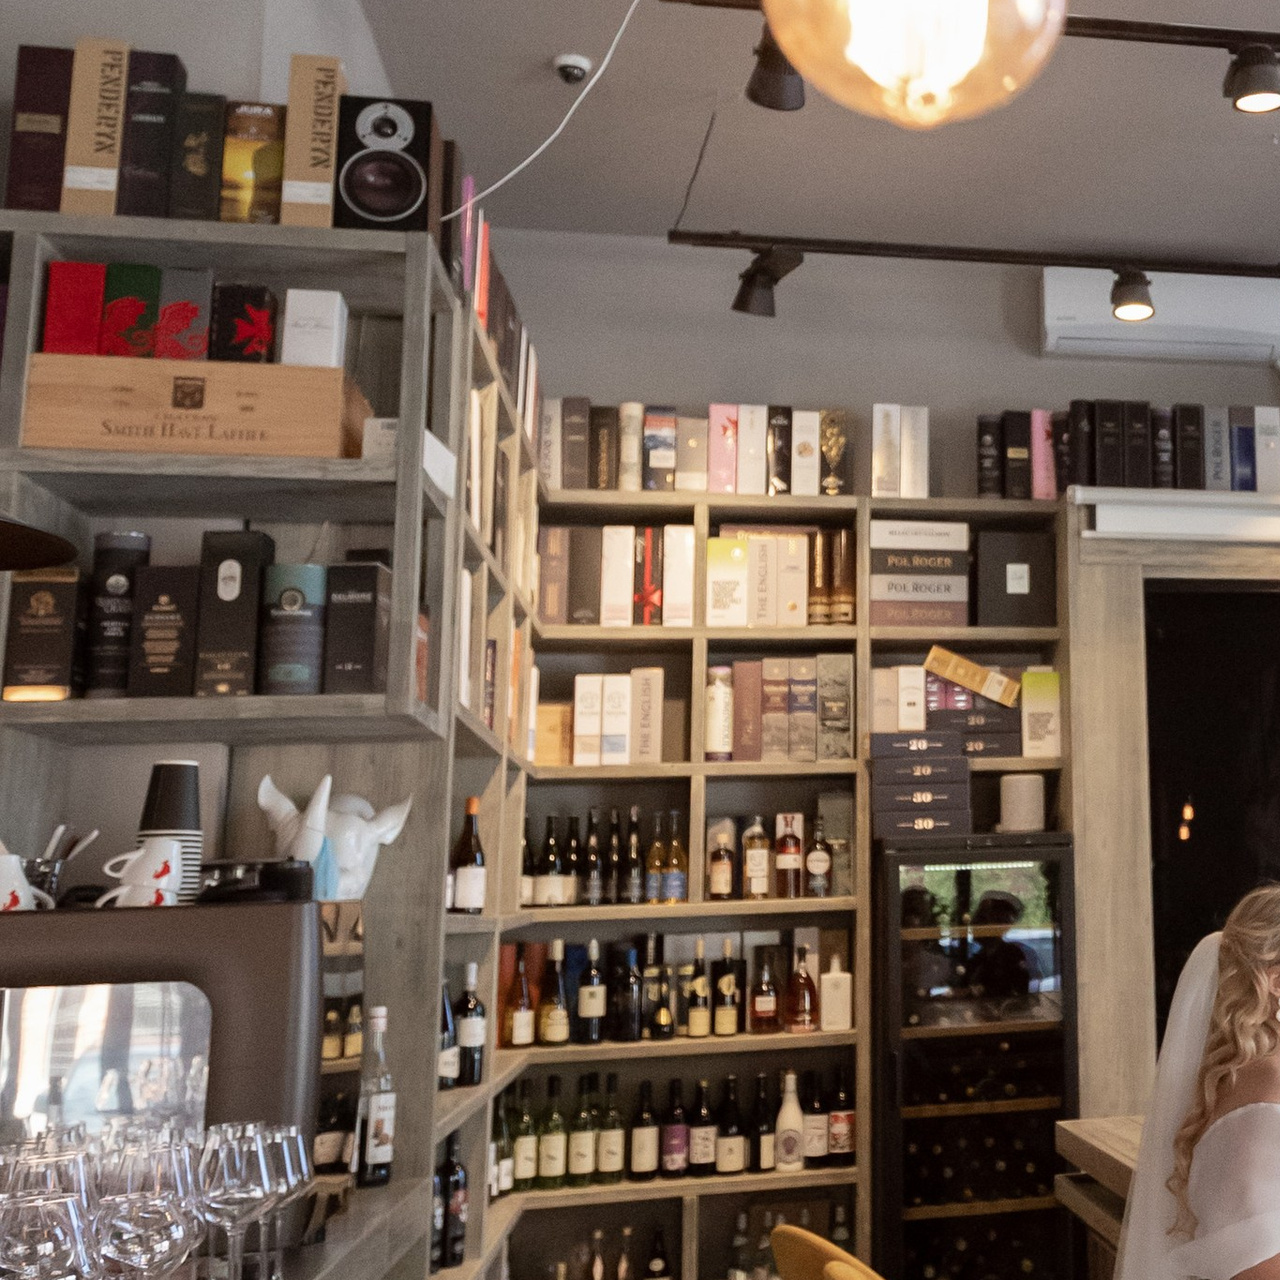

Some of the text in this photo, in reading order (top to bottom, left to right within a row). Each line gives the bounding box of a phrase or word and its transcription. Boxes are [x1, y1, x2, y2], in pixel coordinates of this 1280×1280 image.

[93, 49, 125, 154] PENDERYN
[310, 67, 336, 169] PENDERYN
[887, 554, 952, 568] POL ROGER
[756, 543, 768, 619] THE ENGLISH
[887, 581, 952, 594] POL ROGER
[639, 677, 651, 755] THE ENGLISH
[967, 715, 986, 726] 20
[908, 739, 928, 751] 20
[965, 741, 984, 752] 20
[912, 765, 932, 777] 20
[912, 791, 933, 803] 30
[914, 817, 935, 830] 30
